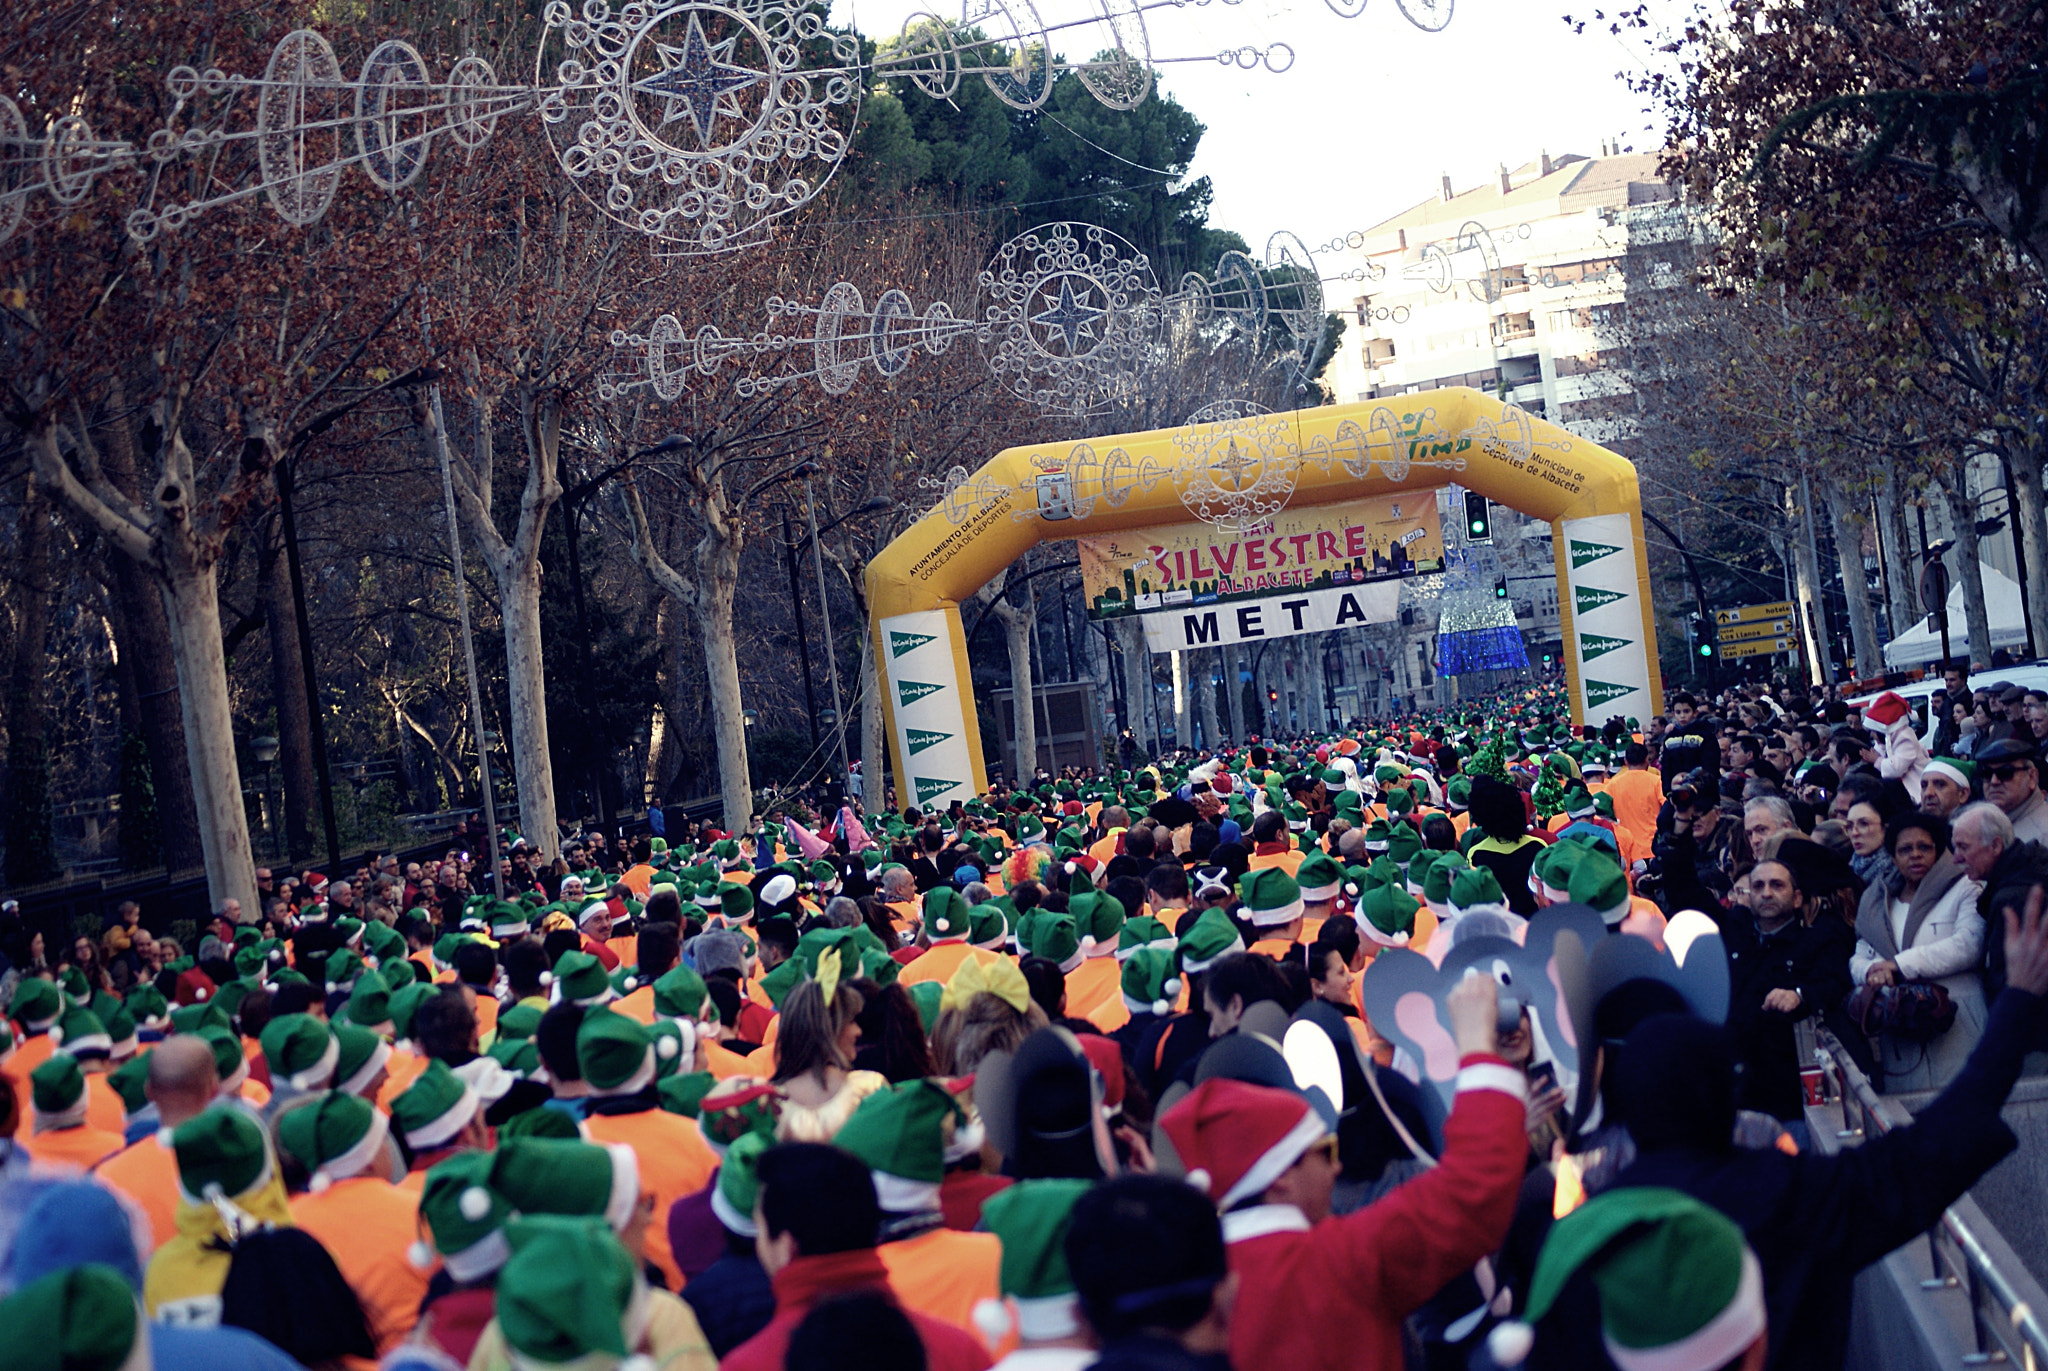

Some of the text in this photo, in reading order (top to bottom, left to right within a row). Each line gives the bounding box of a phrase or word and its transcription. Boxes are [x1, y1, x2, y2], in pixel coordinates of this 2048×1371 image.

[1482, 445, 1580, 494] Deportes de Albacete
[1530, 452, 1573, 477] Municipal
[1573, 472, 1586, 482] de
[961, 534, 974, 545] DE
[972, 502, 1012, 536] DEPORTES
[909, 530, 962, 577] AYUNTAMIENTO
[960, 521, 973, 532] DE
[1154, 525, 1367, 585] SILVESTRE
[1217, 567, 1314, 595] ALBACETE
[1183, 593, 1367, 645] META
[1736, 630, 1761, 638] Llanos
[1740, 647, 1757, 656] José
